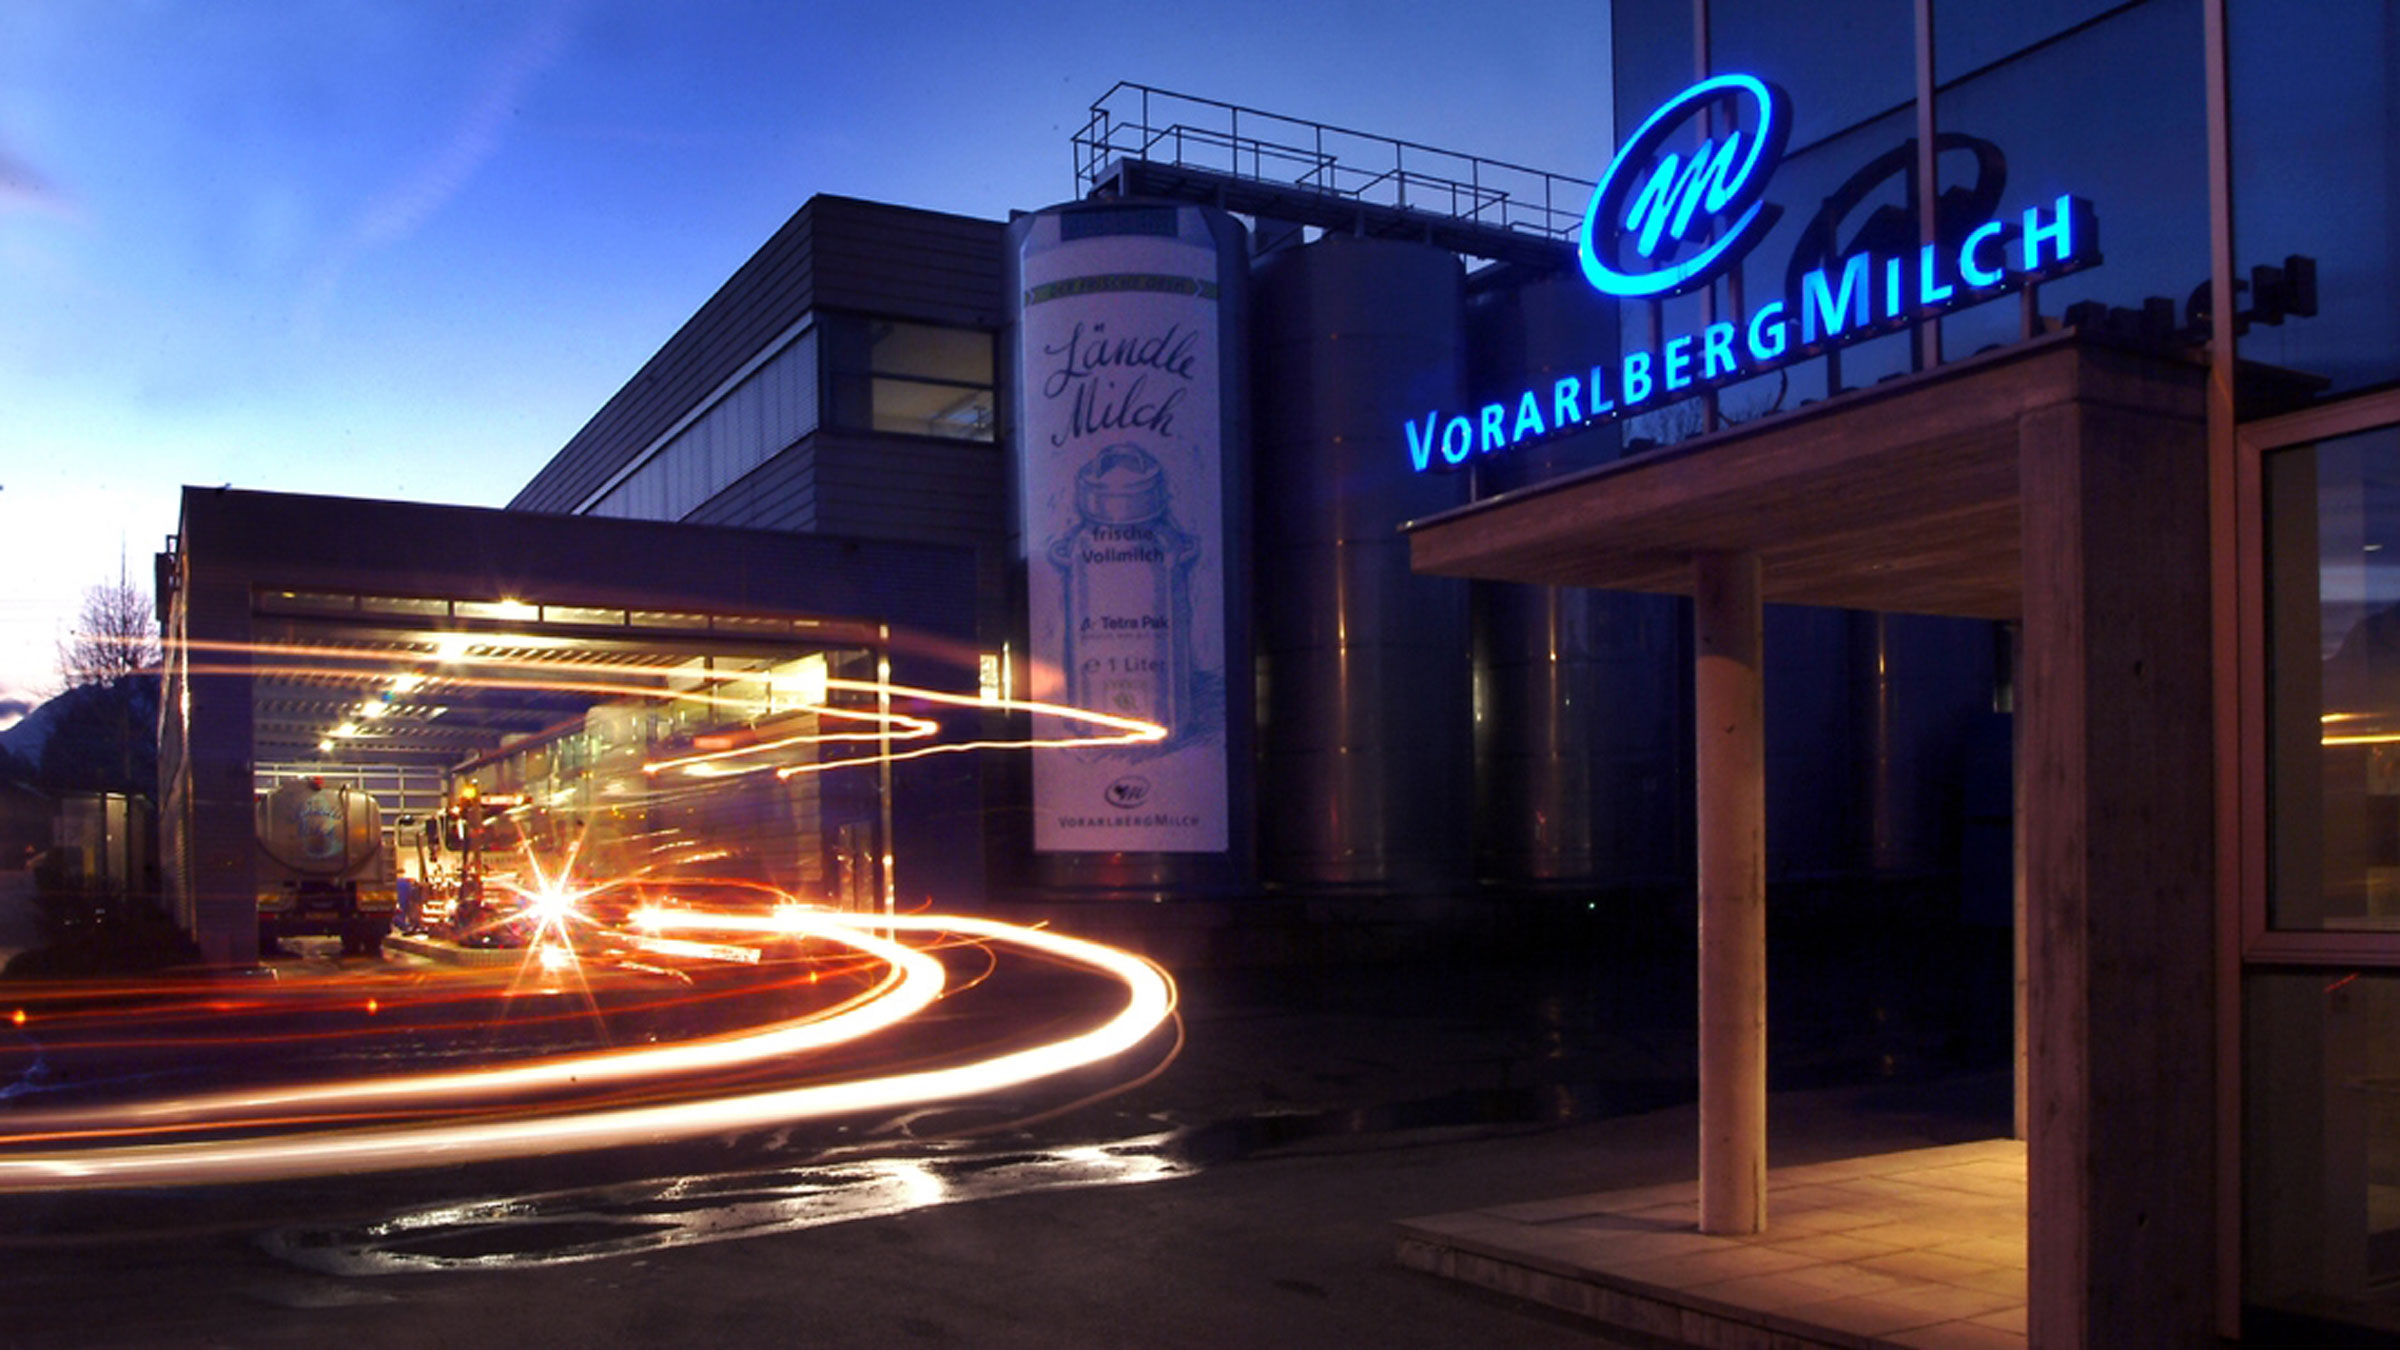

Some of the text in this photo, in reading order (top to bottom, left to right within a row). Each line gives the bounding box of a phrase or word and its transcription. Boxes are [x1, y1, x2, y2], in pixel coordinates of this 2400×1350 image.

[1404, 194, 2073, 473] VORARLBERGMILCH
[1044, 322, 1199, 398] Ländle
[1051, 376, 1186, 447] Milch
[1082, 547, 1165, 564] Vollmilch
[1092, 525, 1154, 542] frische
[1101, 615, 1169, 630] Tetra Pak
